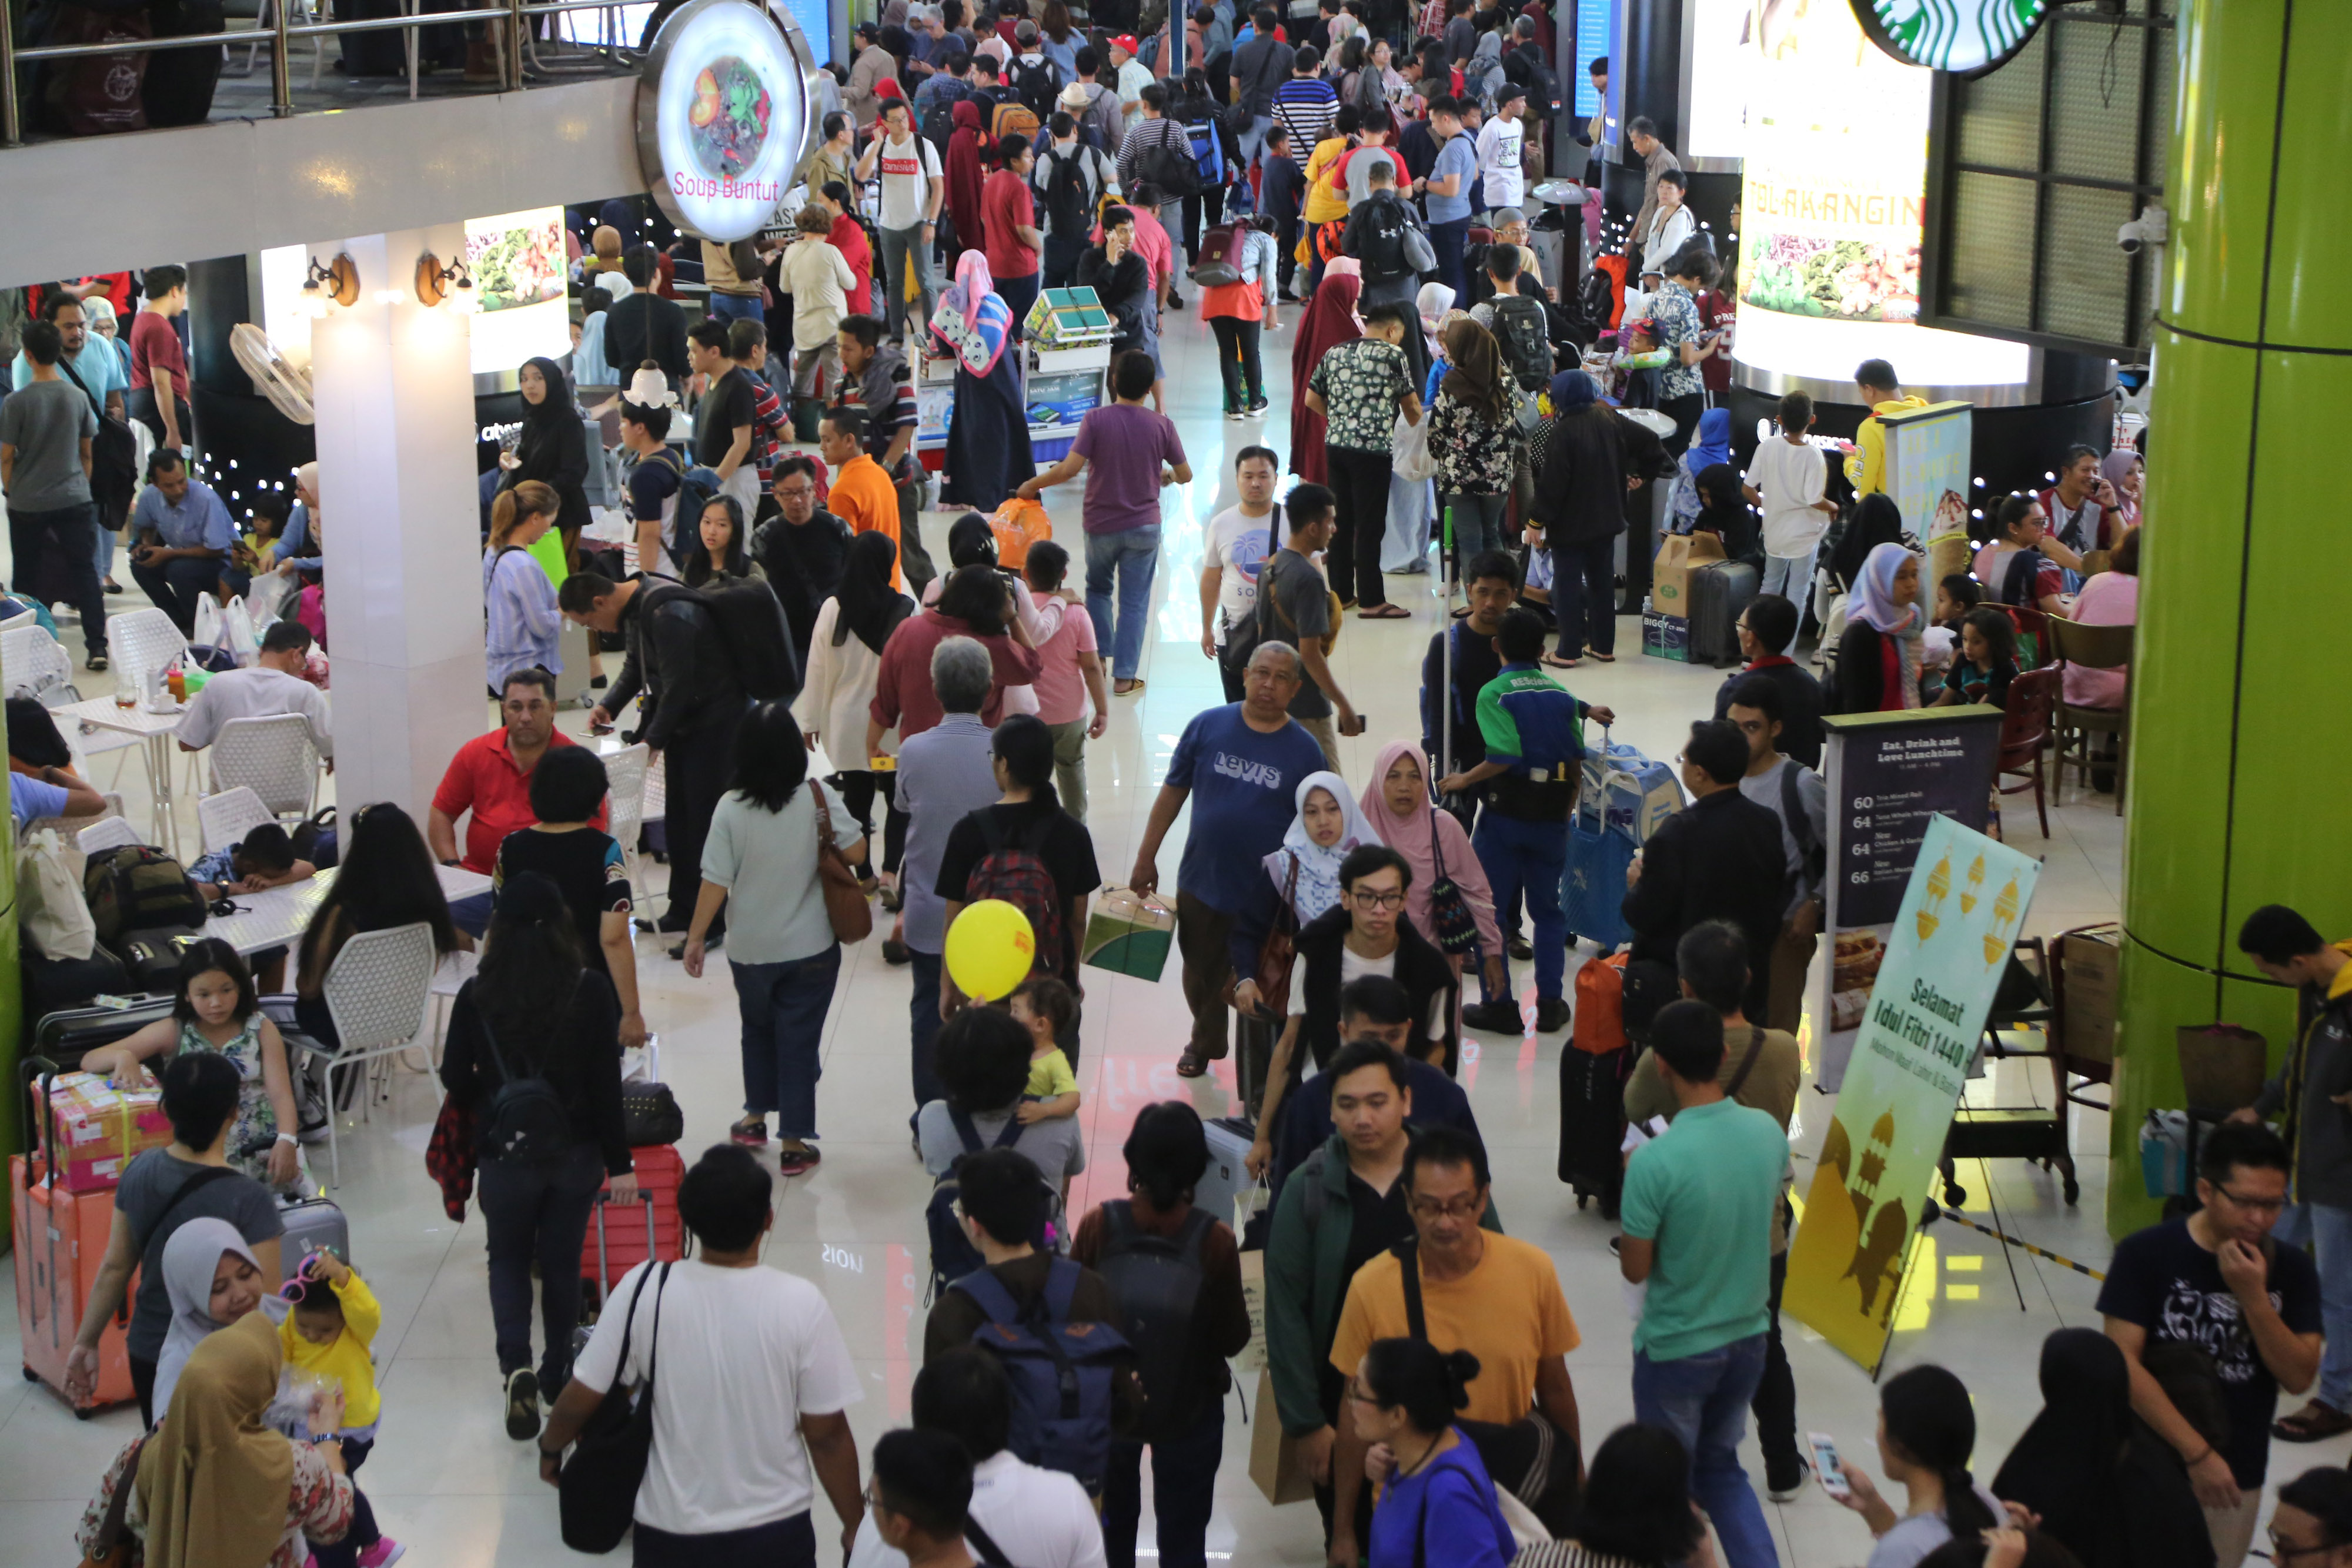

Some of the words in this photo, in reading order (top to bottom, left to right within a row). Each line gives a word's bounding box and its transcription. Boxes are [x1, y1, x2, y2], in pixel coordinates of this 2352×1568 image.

[673, 172, 717, 203] Soup
[723, 174, 779, 201] Buntut
[765, 206, 797, 226] AST
[1713, 313, 1736, 323] PRE
[1238, 587, 1255, 597] SO
[1882, 741, 1904, 750] Eat,
[1906, 738, 1937, 748] Drink
[1939, 737, 1961, 747] and
[1877, 753, 1903, 762] Love
[1905, 748, 1965, 760] Lunchtime
[1853, 796, 1873, 810] 60
[1853, 815, 1872, 829] 64
[1852, 842, 1870, 856] 64
[1851, 871, 1870, 884] 66
[1911, 978, 1965, 1027] Selamat
[1873, 999, 1905, 1035] Idul
[1902, 1014, 1934, 1051] Fitri
[1932, 1031, 1965, 1068] 1440
